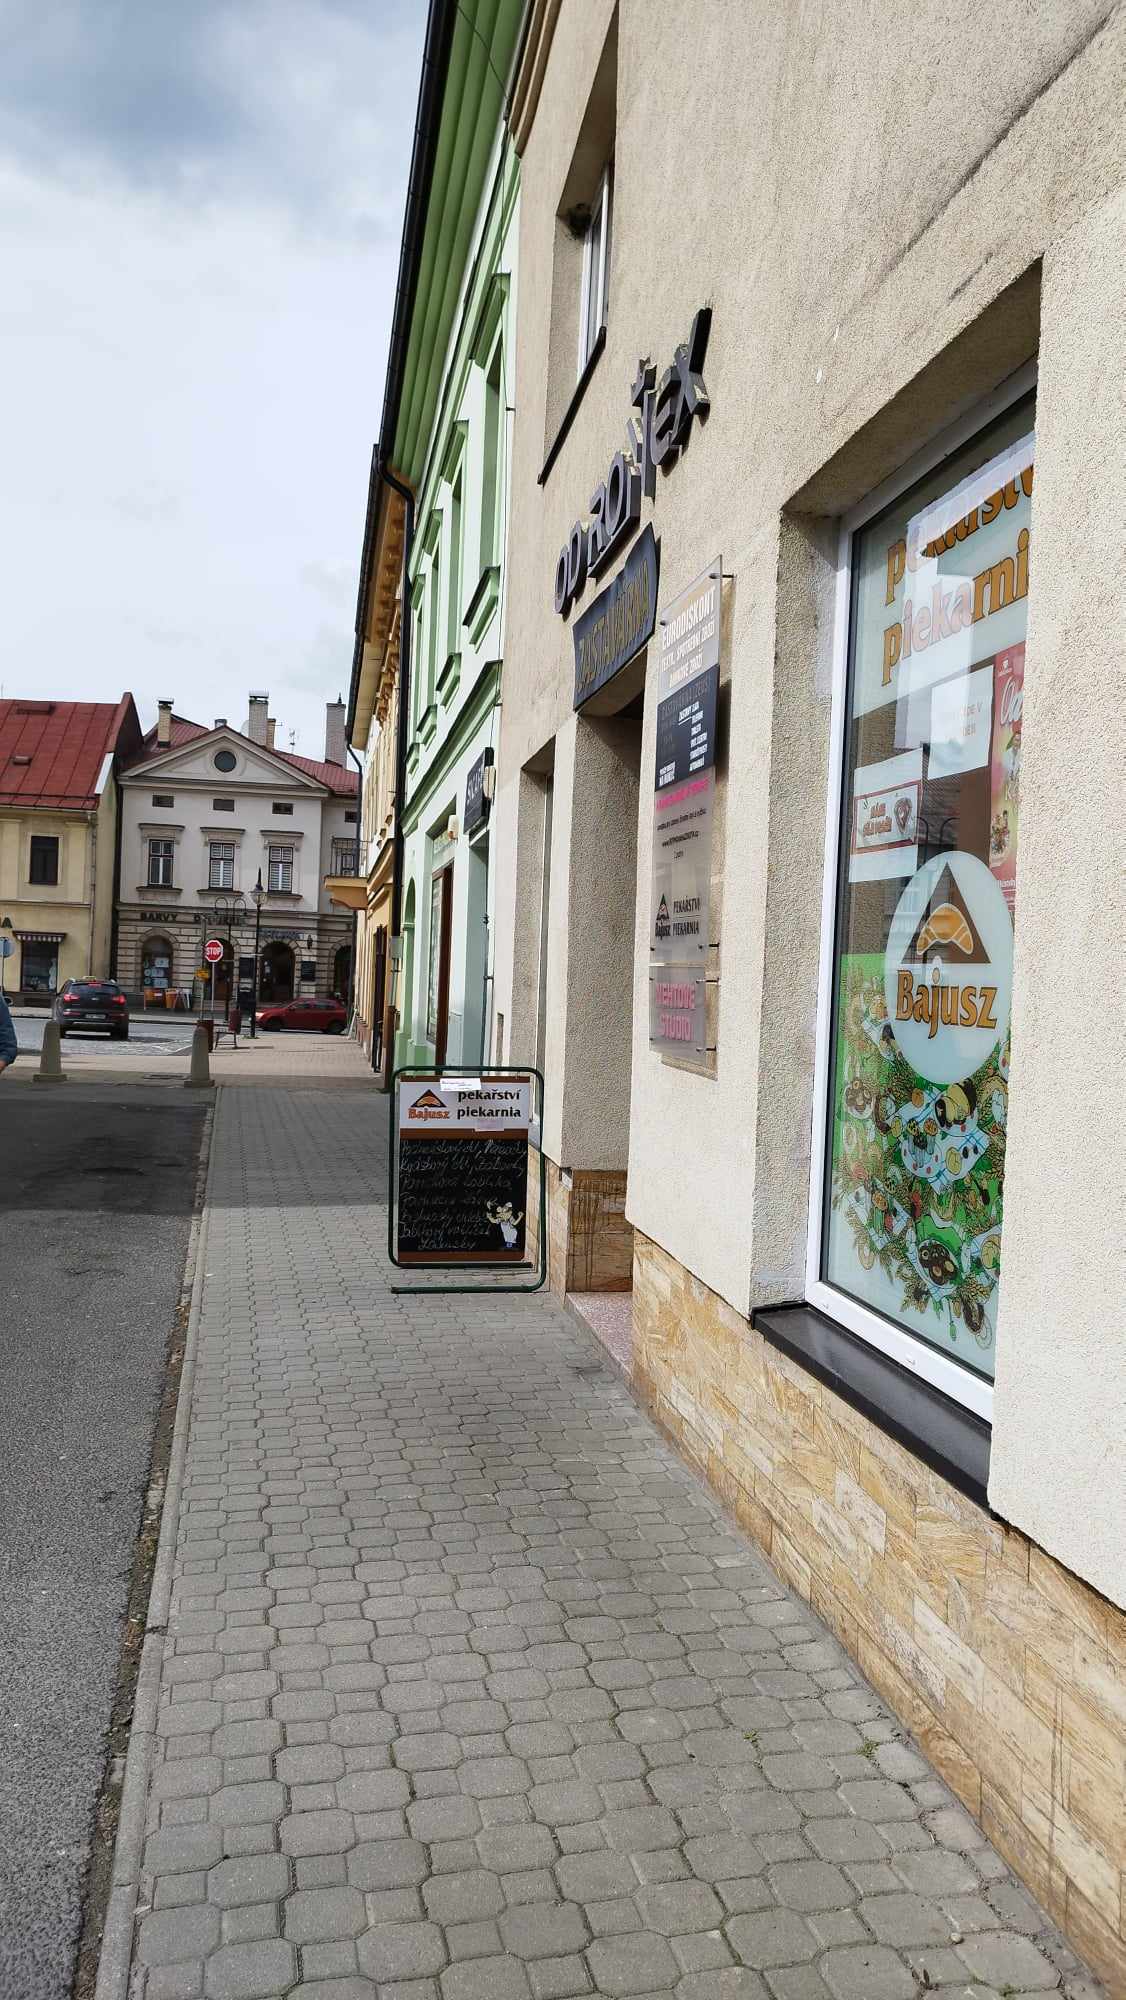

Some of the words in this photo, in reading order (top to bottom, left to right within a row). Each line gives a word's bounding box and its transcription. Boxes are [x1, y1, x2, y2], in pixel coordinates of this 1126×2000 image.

[662, 585, 716, 651] EURODISKONT
[206, 947, 221, 956] STOP
[895, 967, 998, 1039] Bajusz
[458, 1088, 522, 1102] pekařství
[408, 1107, 450, 1121] Bajusz
[457, 1106, 521, 1120] piekarnia
